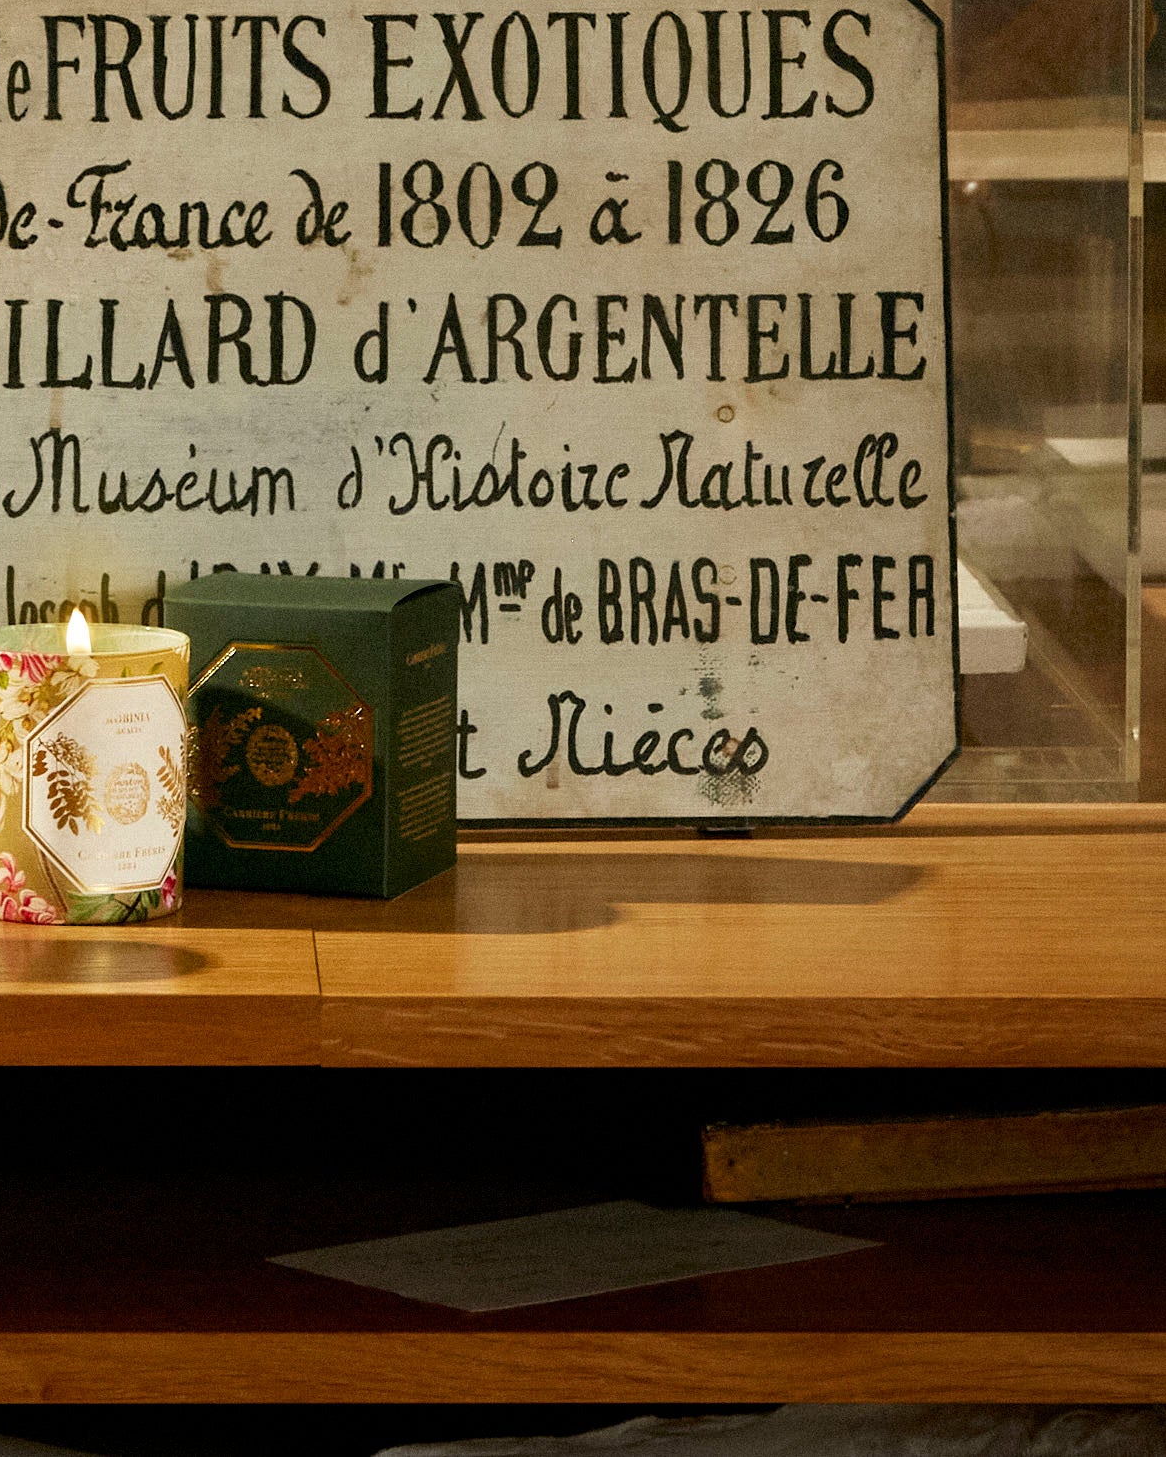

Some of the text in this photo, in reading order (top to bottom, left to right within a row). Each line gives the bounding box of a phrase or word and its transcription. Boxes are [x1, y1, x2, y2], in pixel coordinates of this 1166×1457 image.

[41, 13, 332, 124] FRUITS
[364, 8, 876, 134] EXOTIQUES
[289, 168, 353, 248] de
[377, 159, 564, 250] 1802
[667, 158, 851, 247] 1826
[353, 290, 928, 385] d'ARGENTELLE
[337, 429, 631, 516] d'Histoire
[639, 429, 929, 512] Naturelle
[541, 566, 584, 645] de
[517, 689, 770, 777] Nièces
